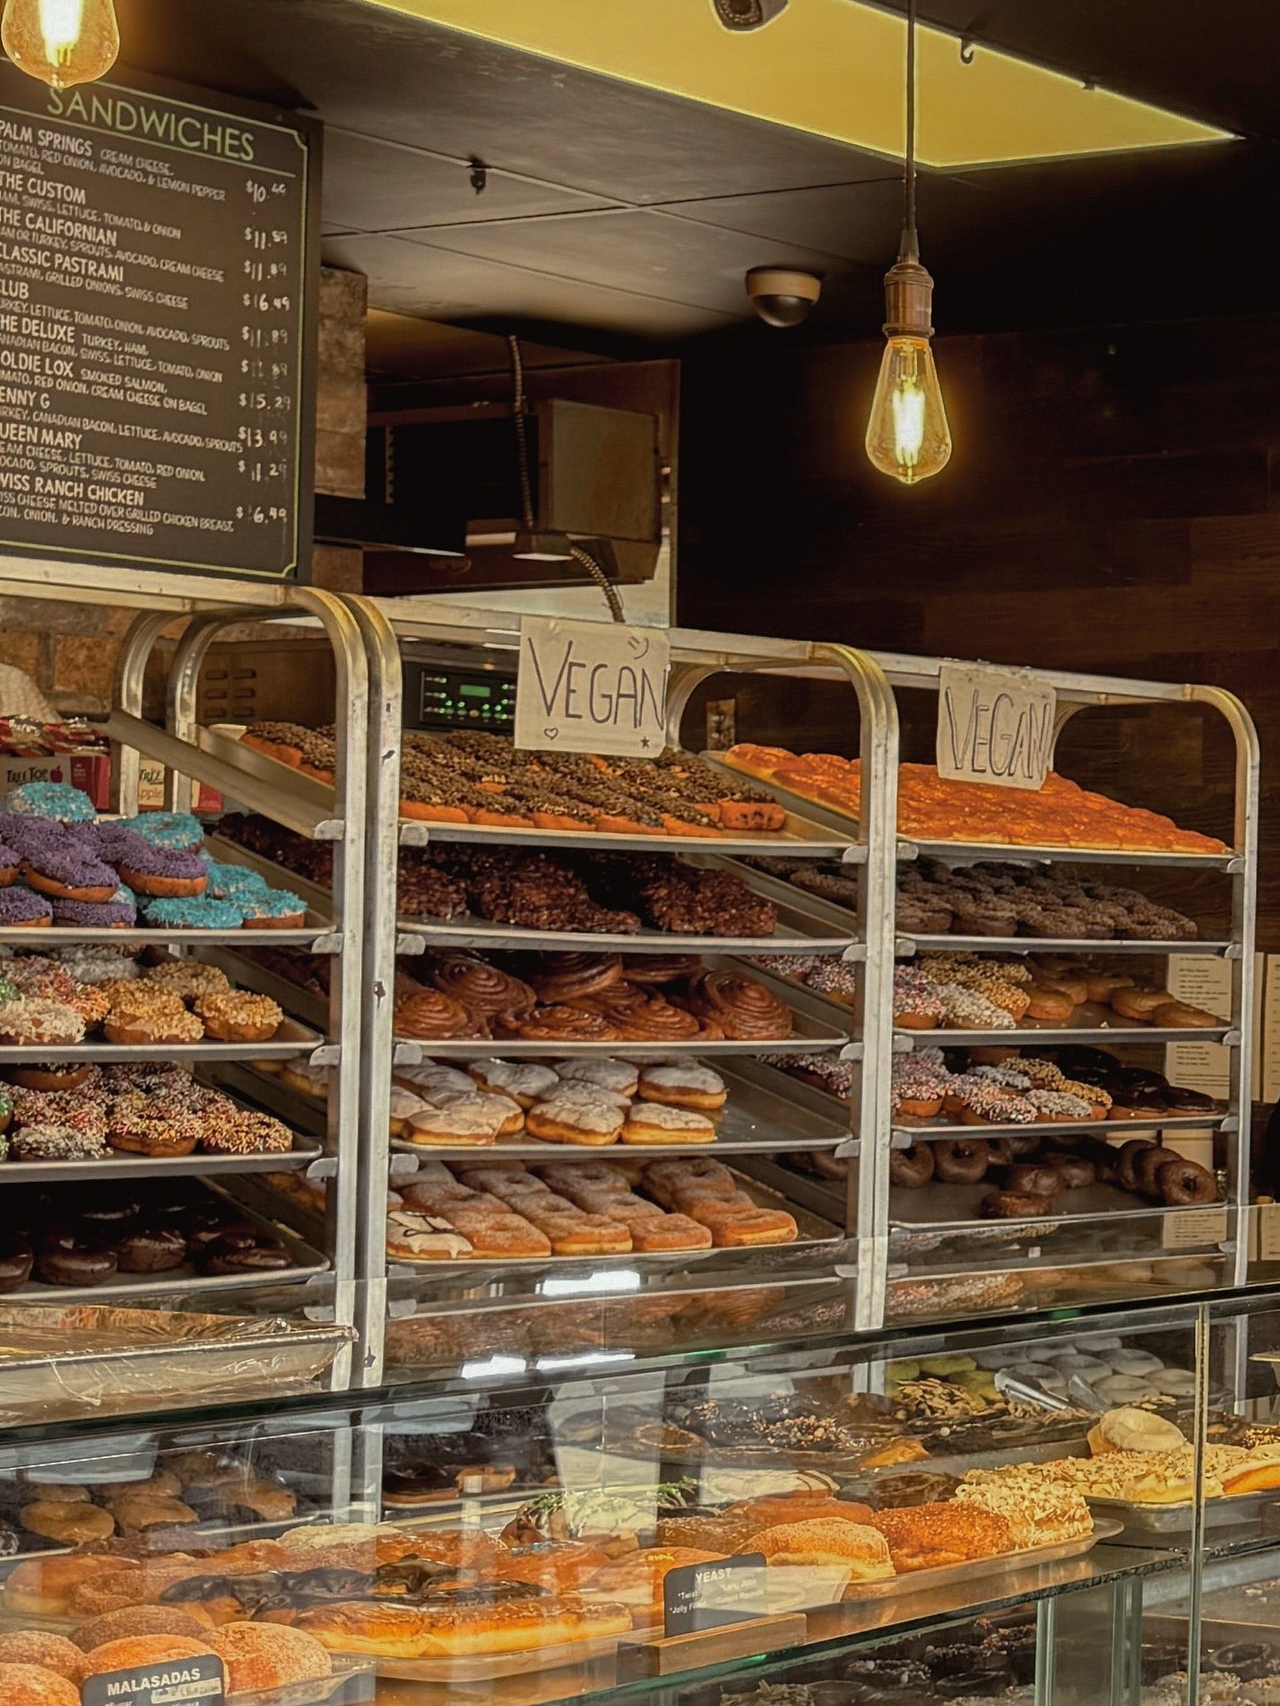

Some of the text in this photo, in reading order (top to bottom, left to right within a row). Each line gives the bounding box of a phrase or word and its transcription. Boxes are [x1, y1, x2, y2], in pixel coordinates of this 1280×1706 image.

[47, 88, 254, 161] SANDWICHES
[38, 129, 93, 157] SPRINGS
[101, 148, 133, 167] CREAM
[41, 148, 61, 164] RED
[157, 177, 190, 194] LEMON
[191, 184, 226, 202] PEPPER
[27, 177, 86, 205] CUSTOM
[25, 213, 117, 246] CALIFORNIAN
[152, 225, 181, 240] ONION
[16, 229, 29, 241] OR
[160, 258, 191, 274] CREAM
[192, 267, 224, 282] CHEESE
[55, 253, 124, 282] PASTRAMI
[46, 271, 83, 288] GRILLED
[125, 287, 154, 302] SWISS
[156, 294, 189, 309] CHEESE
[22, 318, 76, 343] DELUXE
[191, 334, 230, 351] SPROUTS
[1, 350, 41, 373] OLDIE
[44, 358, 74, 378] LOX
[81, 368, 122, 386] SMOKED
[195, 368, 222, 382] ONION
[0, 387, 50, 409] ENNY G
[34, 374, 54, 389] RED
[91, 385, 124, 401] CREAM
[126, 391, 161, 407] CHEESE
[163, 398, 178, 410] ON
[178, 400, 208, 415] BAGEL
[0, 423, 82, 451] UEEN MARY
[32, 411, 82, 429] CANADIAN
[205, 437, 243, 454] SPROUTS
[91, 469, 121, 484] SWISS
[122, 474, 157, 489] CHEESE
[156, 465, 174, 477] RED
[35, 479, 144, 507] RANCH CHICKEN
[17, 496, 56, 511] CHEESE
[59, 501, 97, 517] MELTED
[99, 506, 124, 519] OVER
[126, 508, 161, 523] GRILLED
[163, 514, 198, 528] CHICKEN
[72, 515, 104, 530] RANCH
[106, 521, 154, 536] DRESSING
[528, 637, 667, 731] VEGAN
[945, 686, 1051, 781] VEGAN
[29, 767, 48, 780] TOP
[138, 788, 162, 801] pple
[695, 1568, 732, 1584] YEAST
[107, 1668, 200, 1696] MALASADAS
